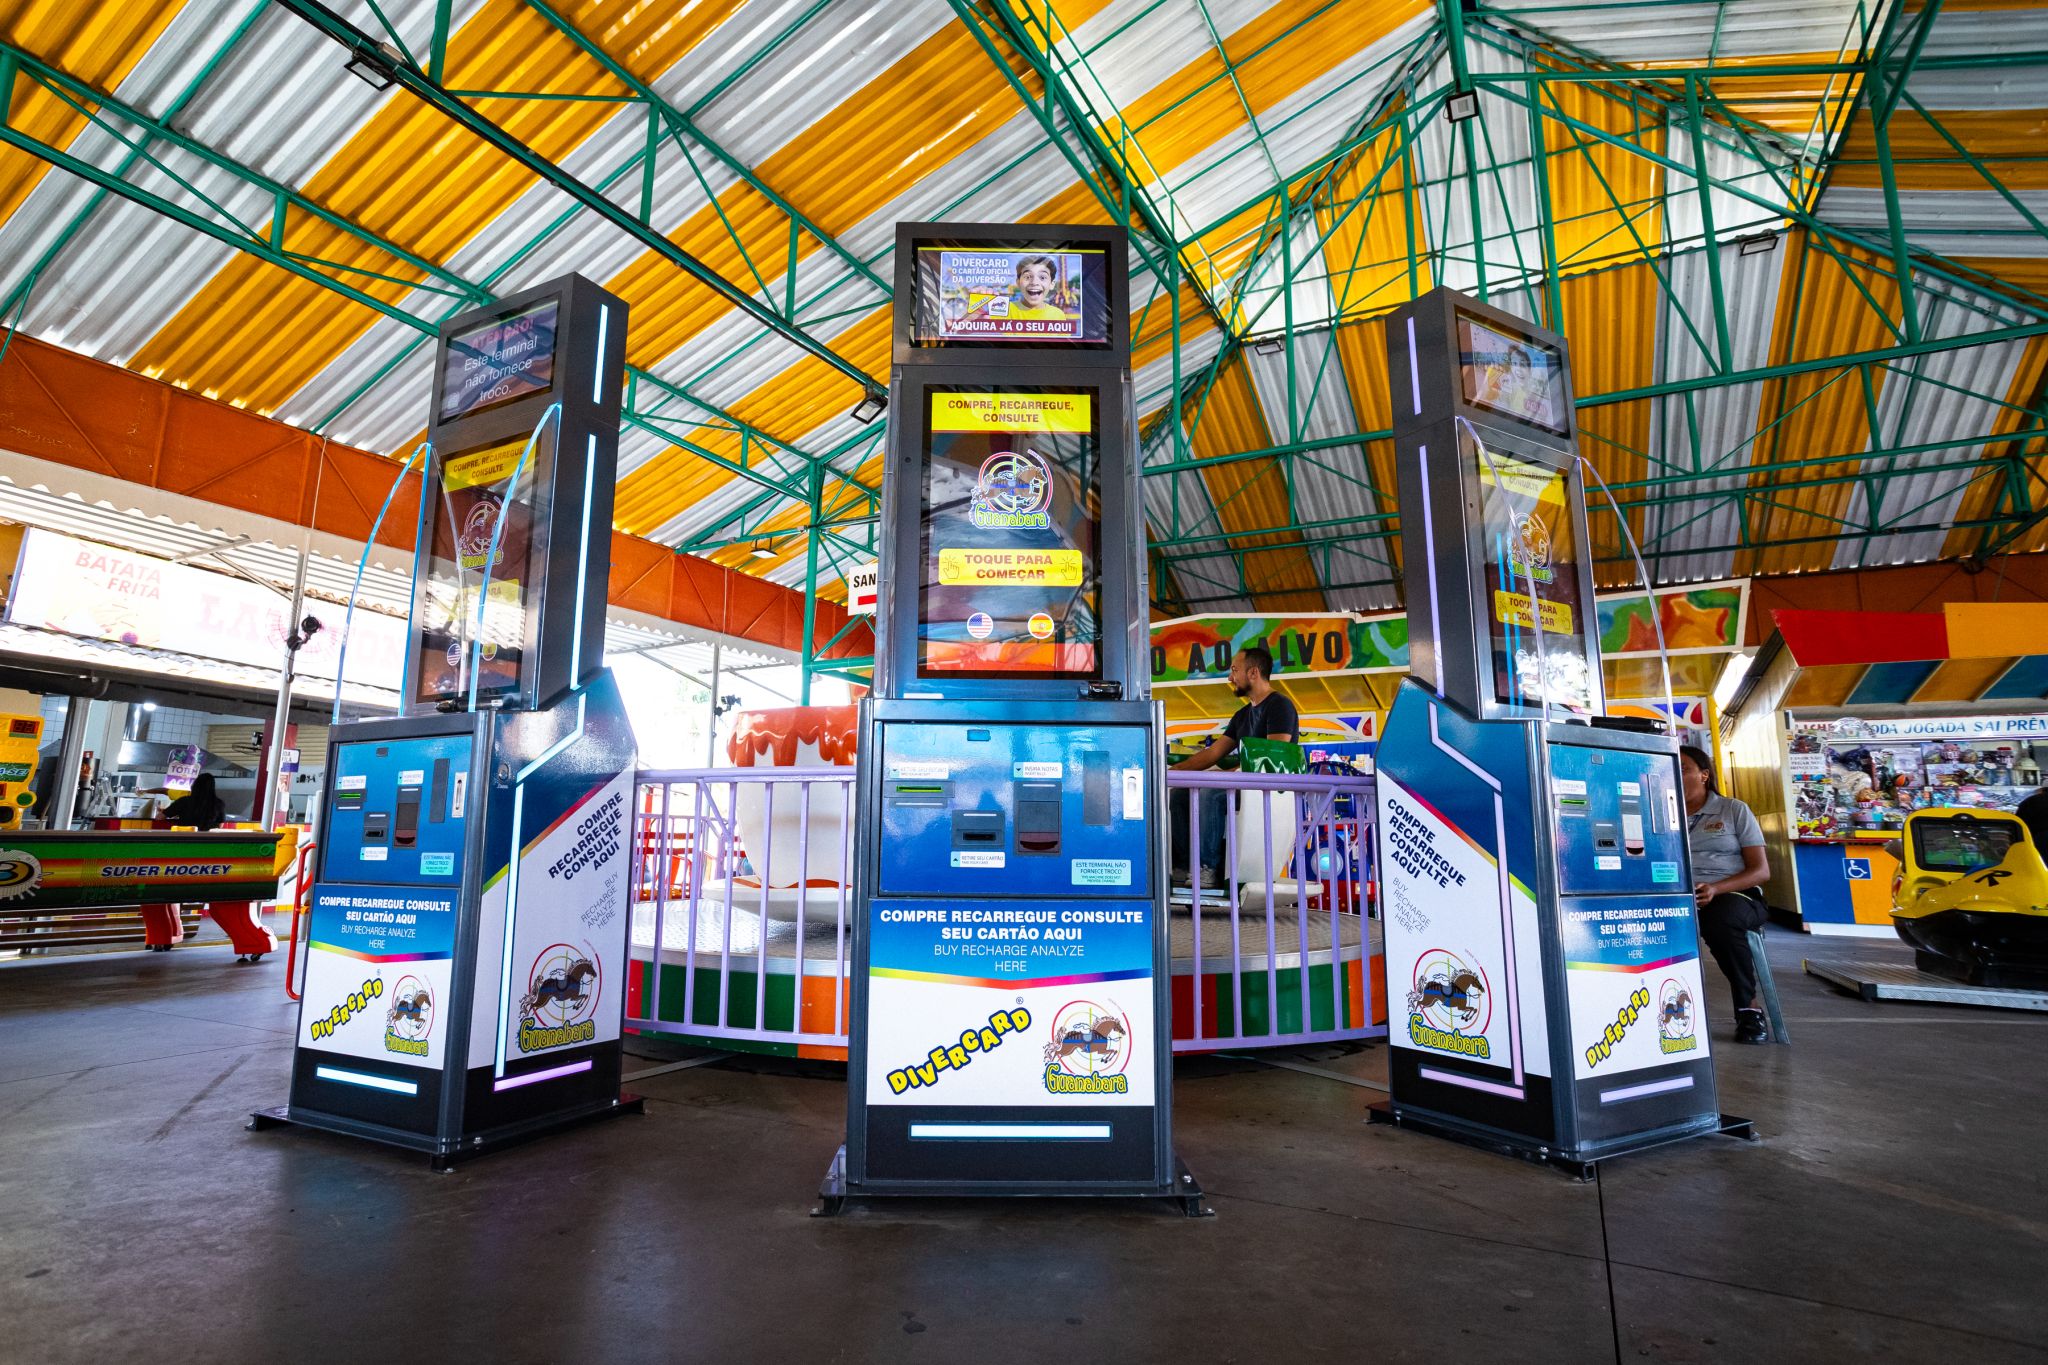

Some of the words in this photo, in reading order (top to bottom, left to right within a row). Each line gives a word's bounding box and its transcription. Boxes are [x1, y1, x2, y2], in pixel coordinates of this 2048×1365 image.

[952, 258, 1009, 268] DIVERCARD
[958, 267, 985, 275] CARTÃO
[966, 275, 1006, 284] DIVERSÃO
[952, 322, 997, 332] ADQUIRA
[1000, 320, 1012, 331] JÁ
[1016, 322, 1024, 331] O
[1026, 322, 1044, 332] SEU
[1048, 322, 1072, 332] AQUI
[464, 355, 488, 372] Este
[491, 335, 538, 365] terminal
[465, 374, 486, 389] não
[489, 358, 533, 381] fornece
[948, 400, 996, 410] COMPRE,
[1000, 401, 1074, 412] RECARREGUE,
[983, 414, 1039, 423] CONSULTE
[472, 464, 504, 479] CONSULTE
[974, 502, 1049, 528] Guanabara
[74, 550, 161, 584] BATATA
[964, 554, 1012, 564] TOQUE
[1016, 555, 1053, 564] PARA
[976, 569, 1046, 582] COMEÇAR
[107, 577, 160, 600] FRITA
[1188, 640, 1232, 674] AO
[1904, 722, 1966, 734] JOGADA
[1974, 720, 2000, 732] SAI
[577, 792, 624, 836] COMPRE
[1388, 798, 1436, 844] COMPRE
[548, 808, 622, 879] RECARREGUE
[564, 824, 622, 880] CONSULTE
[1389, 815, 1466, 887] RECARREGUE
[594, 842, 620, 871] AQUI
[1389, 832, 1450, 888] CONSULTE
[1391, 850, 1420, 879] AQUI
[101, 866, 159, 878] SUPER
[164, 864, 231, 876] HOCKEY
[604, 872, 618, 888] BUY
[1392, 878, 1408, 892] BUY
[320, 896, 352, 908] COMPRE
[352, 898, 404, 910] RECARREGUE
[406, 900, 451, 912] CONSULTE
[580, 885, 618, 923] RECHARGE
[586, 896, 617, 929] ANALYZE
[1394, 889, 1431, 927] RECHARGE
[346, 912, 362, 922] SEU
[363, 910, 394, 923] CARTÃO
[396, 914, 416, 924] AQUI
[597, 910, 616, 930] HERE
[880, 910, 947, 922] COMPRE
[951, 910, 1056, 923] RECARREGUE
[1060, 910, 1143, 923] CONSULTE
[1394, 902, 1426, 934] ANALYZE
[1394, 914, 1414, 934] HERE
[1568, 910, 1602, 922] COMPRE
[1604, 908, 1652, 920] RECARREGUE
[1654, 907, 1690, 918] CONSULTE
[341, 924, 354, 934] BUY
[354, 926, 387, 936] RECHARGE
[388, 928, 416, 938] ANALYZE
[941, 928, 973, 940] SEU
[976, 925, 1040, 940] CARTÃO
[1044, 928, 1082, 940] AQUI
[1600, 924, 1616, 935] SEU
[1617, 920, 1646, 934] CARTÃO
[1648, 922, 1666, 932] AQUI
[368, 939, 386, 949] HERE
[934, 945, 958, 956] BUY
[962, 945, 1028, 956] RECHARGE
[1030, 945, 1085, 956] ANALYZE
[1598, 938, 1611, 948] BUY
[1612, 936, 1642, 948] RECHARGE
[1644, 935, 1668, 946] ANALYZE
[1628, 950, 1644, 960] HERE
[994, 961, 1028, 972] HERE
[310, 977, 384, 1041] DIVERCARD
[519, 1017, 594, 1054] Guanabara
[1409, 1012, 1490, 1060] Guanabara
[1586, 987, 1650, 1068] DIVERCARD
[886, 1007, 1032, 1095] DIVERCARD
[1045, 1062, 1128, 1094] Guanabara
